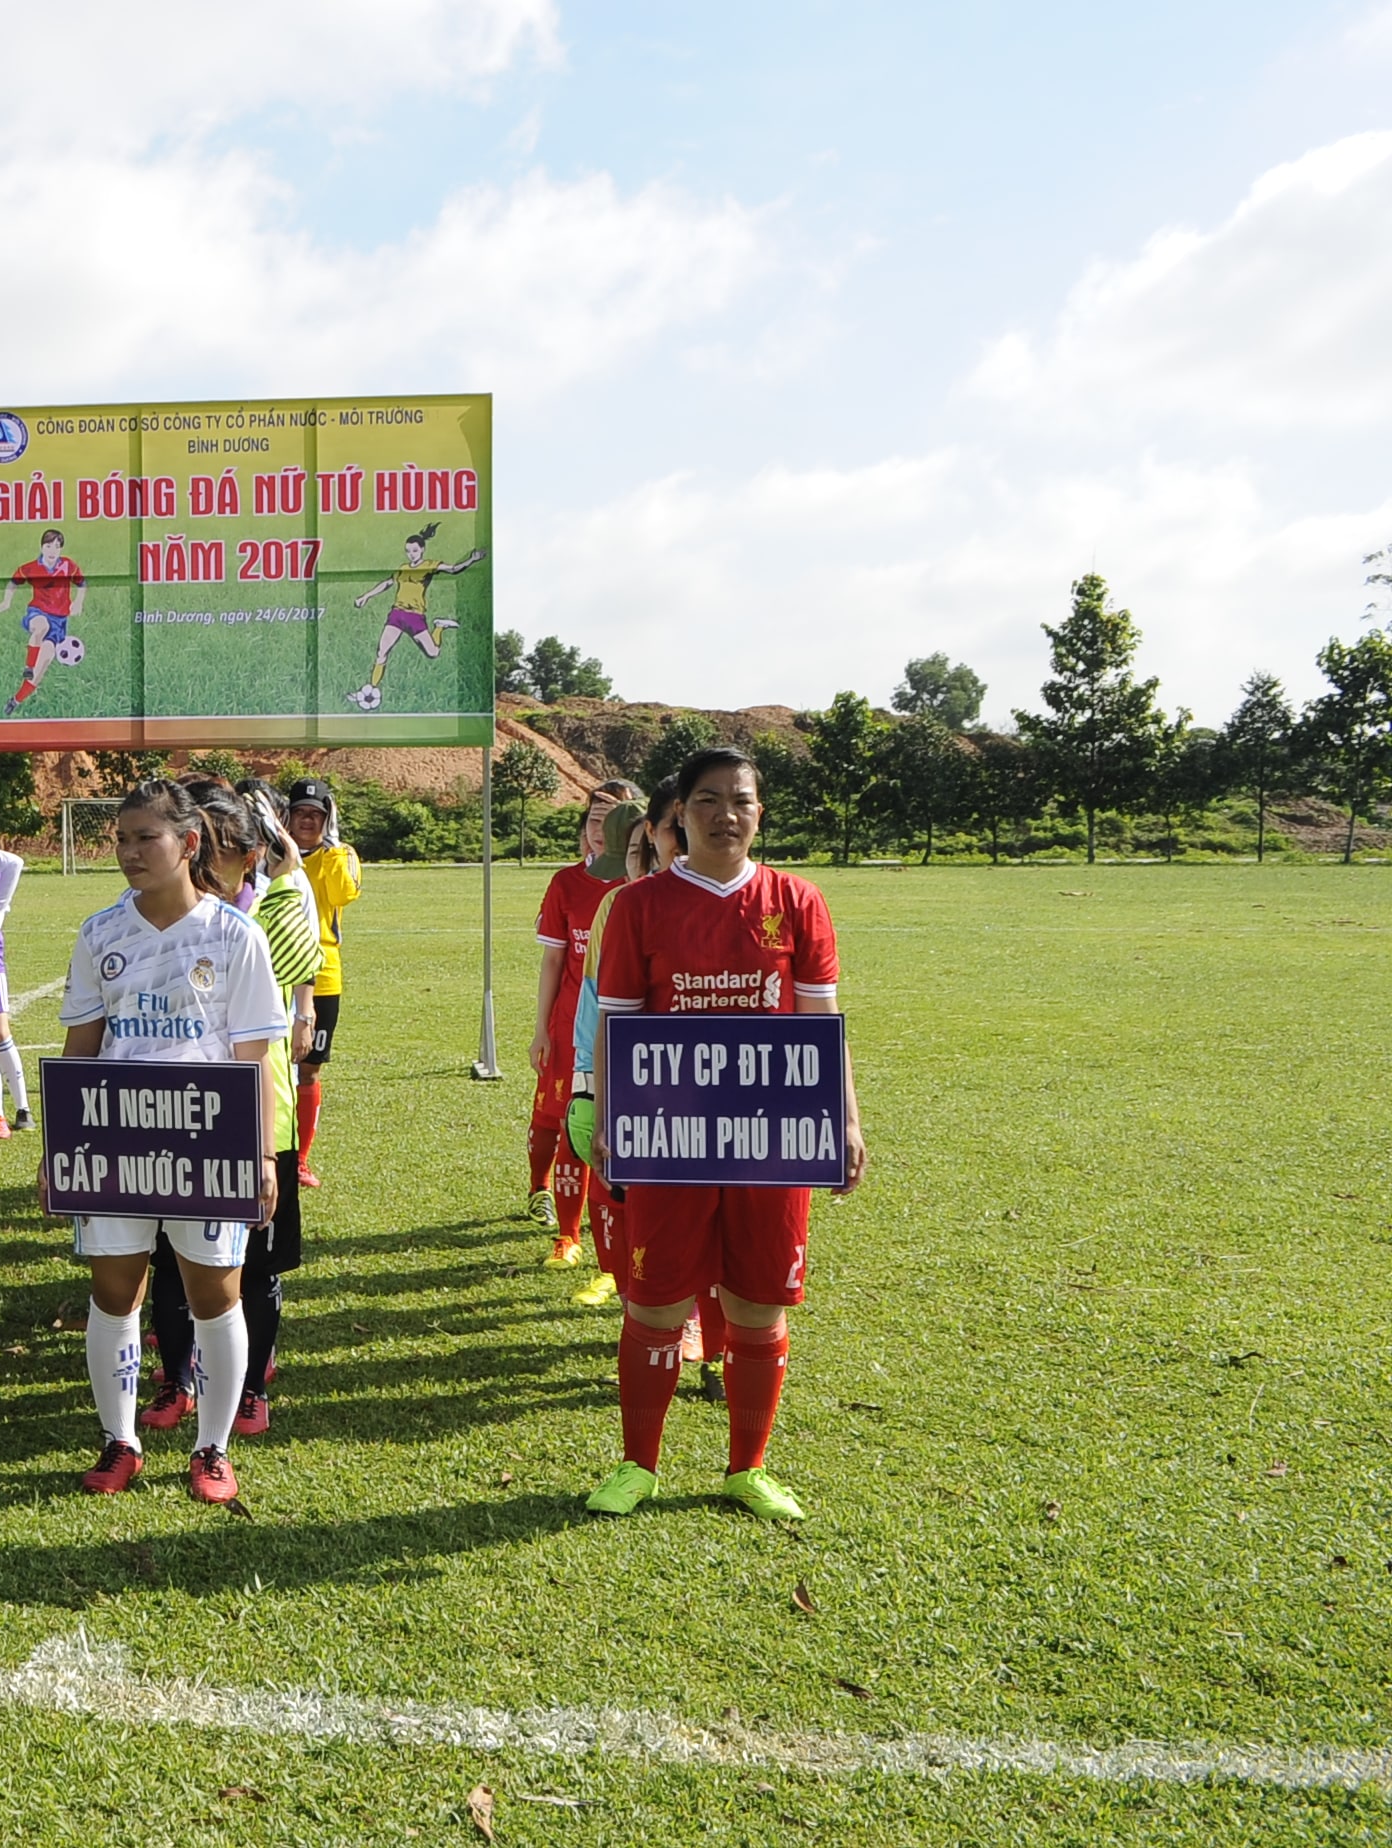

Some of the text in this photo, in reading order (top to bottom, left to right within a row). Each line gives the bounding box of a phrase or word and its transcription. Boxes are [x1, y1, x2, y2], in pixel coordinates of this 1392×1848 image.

[78, 414, 115, 433] ĐOÀN
[163, 411, 201, 431] CÔNG
[205, 415, 222, 429] TY
[188, 435, 270, 454] BÌNH DƯƠNG
[77, 469, 177, 520] BÓNG
[189, 467, 239, 517] ĐÁ
[253, 465, 307, 515] NỮ
[315, 463, 364, 514] TỨ
[374, 462, 478, 512] HÙNG
[138, 534, 323, 584] NĂM 2017
[134, 609, 163, 623] Bình
[219, 610, 252, 624] ngày
[255, 606, 326, 622] 24/6/2017
[671, 969, 762, 992] Standard
[137, 992, 168, 1014] Fly
[670, 989, 760, 1013] Chartered
[108, 1012, 205, 1040] Emirates
[632, 1043, 820, 1087] CTY CP ĐT XD
[81, 1079, 221, 1139] XÍ NGHIỆP
[616, 1107, 837, 1161] CHÁNH PHÚ HOÀ
[53, 1142, 255, 1199] CẤP NƯỚC KLH
